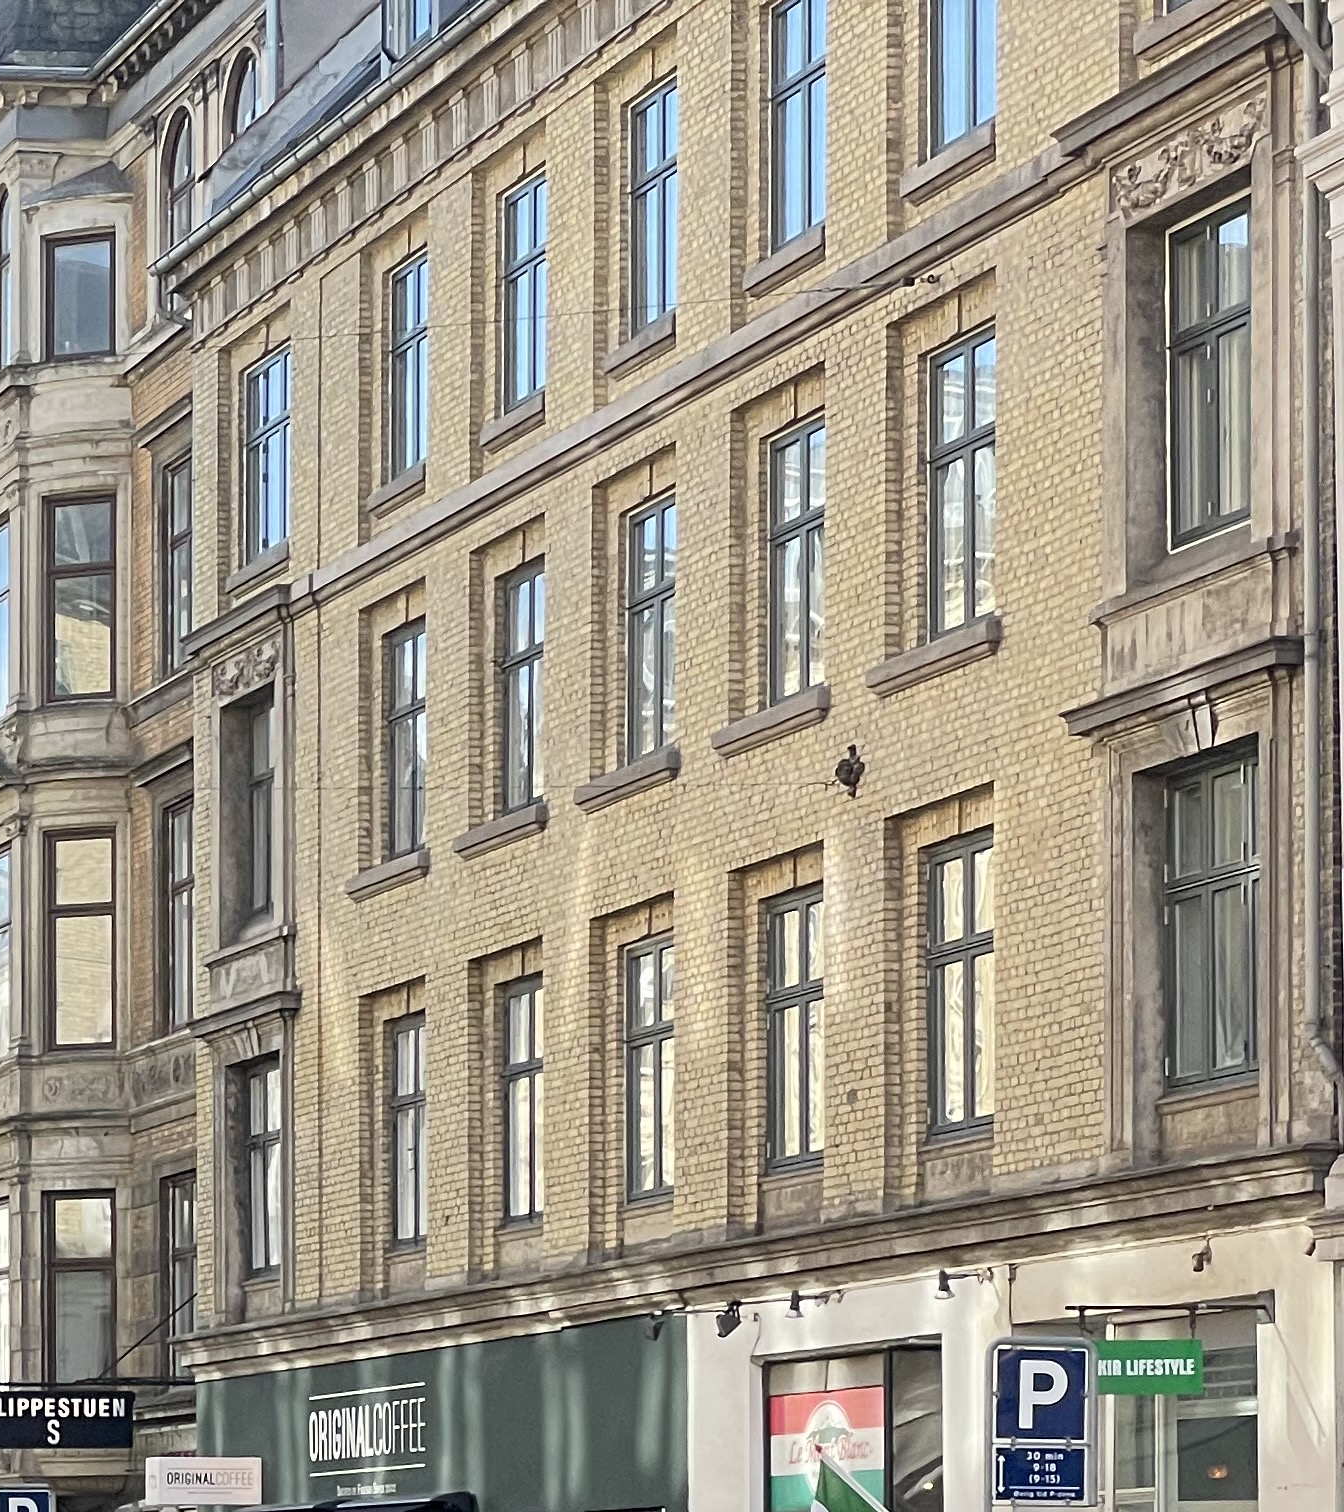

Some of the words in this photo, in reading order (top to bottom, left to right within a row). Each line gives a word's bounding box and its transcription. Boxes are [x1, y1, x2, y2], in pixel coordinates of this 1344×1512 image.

[1126, 1358, 1195, 1376] LIFESTYLE
[1018, 1359, 1069, 1430] P
[46, 1419, 60, 1445] S
[309, 1397, 426, 1462] ORIGINALCOFFEE
[1026, 1451, 1041, 1461] 30
[1045, 1452, 1064, 1460] min
[1032, 1463, 1057, 1472] 9-18
[166, 1471, 254, 1486] ORIGINALCOFFEE
[1029, 1474, 1061, 1484] (9-15)
